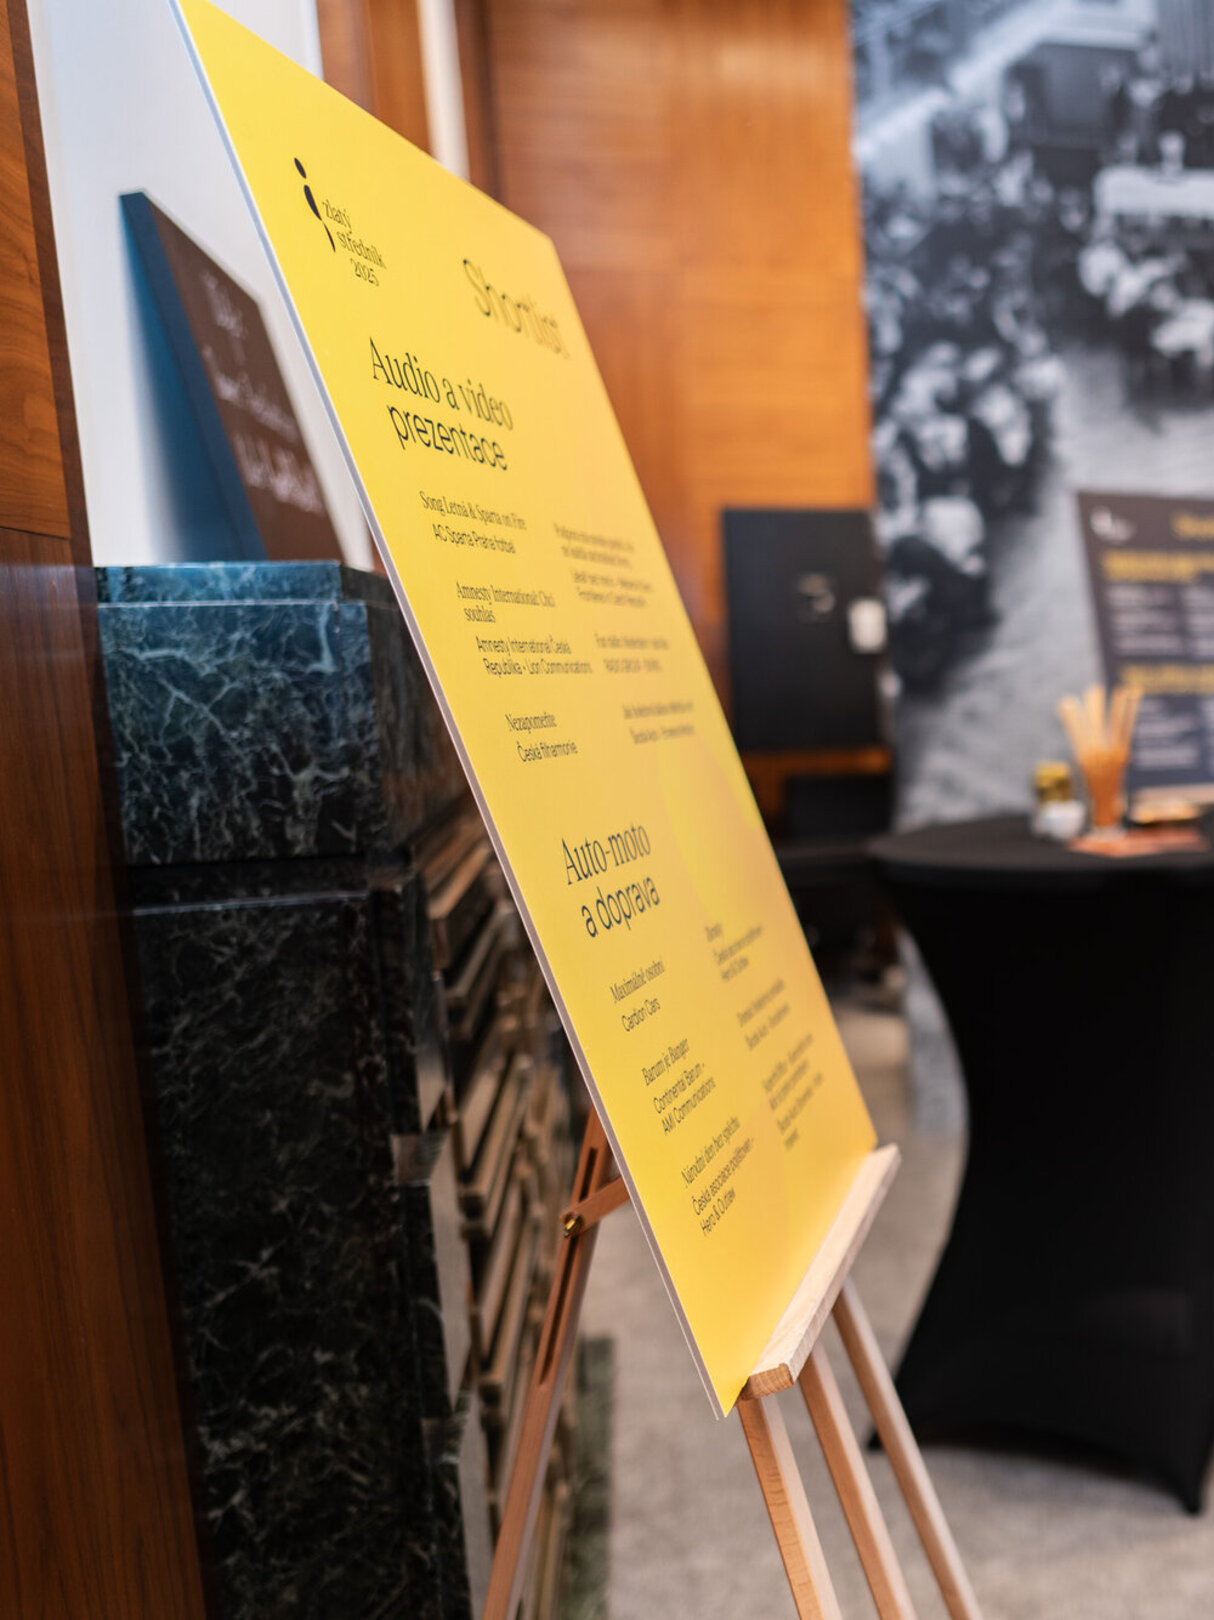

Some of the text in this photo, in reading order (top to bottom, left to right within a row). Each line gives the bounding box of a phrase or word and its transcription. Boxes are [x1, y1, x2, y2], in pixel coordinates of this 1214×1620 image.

[321, 199, 352, 229] zlatý
[350, 257, 380, 287] 2025
[462, 258, 572, 361] Shortlist
[369, 336, 514, 432] Audio a video
[386, 404, 508, 471] prezentace
[419, 490, 446, 517] Song
[455, 581, 492, 607] Amnesty
[475, 635, 510, 656] Amnesty
[561, 823, 651, 886] Auto-moto
[581, 876, 660, 938] a doprava
